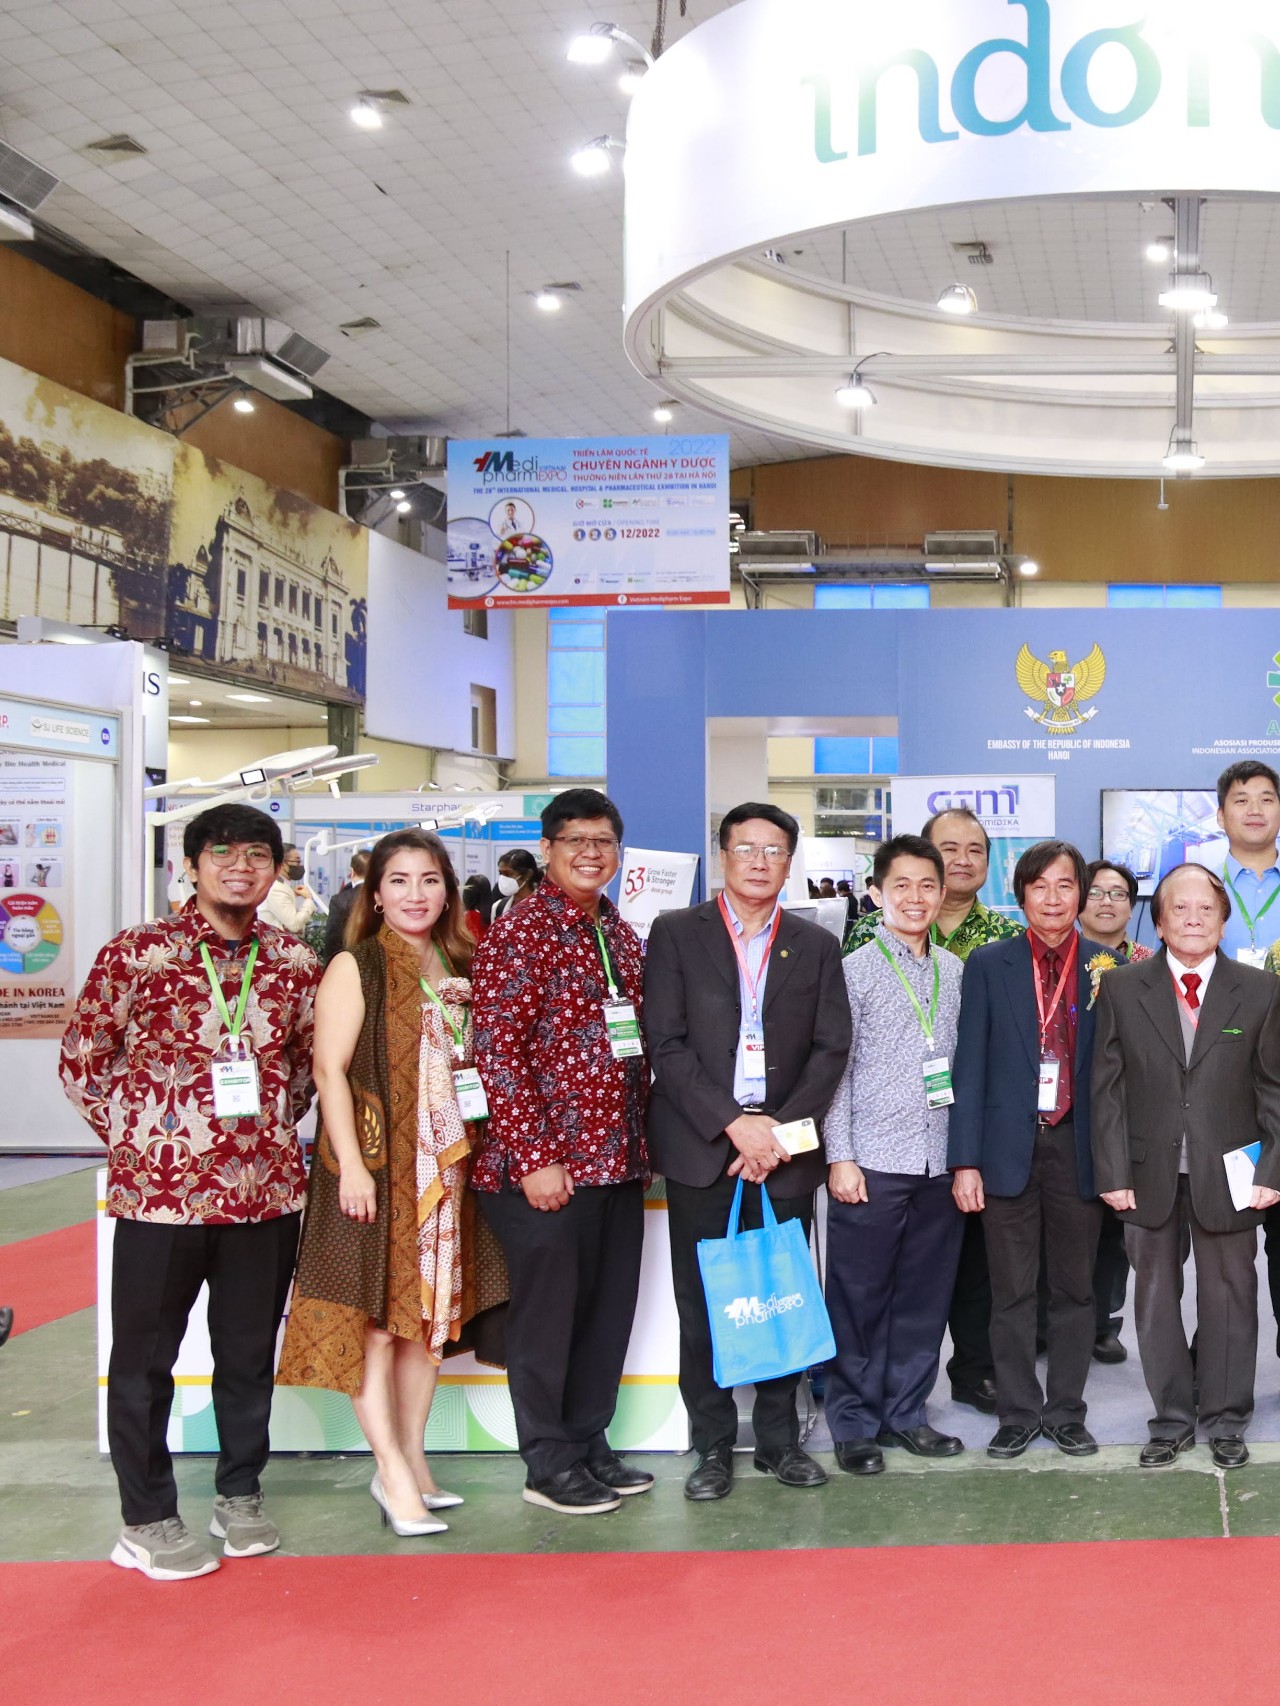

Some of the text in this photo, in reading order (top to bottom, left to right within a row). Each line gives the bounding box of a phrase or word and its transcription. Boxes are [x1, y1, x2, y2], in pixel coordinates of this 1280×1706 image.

[669, 439, 716, 455] 2022
[572, 458, 621, 471] CHUYÊN
[671, 459, 678, 468] Y
[497, 486, 540, 494] INTERNATIONAL
[621, 528, 660, 538] 12/2022
[66, 726, 89, 738] SCIENCE
[987, 739, 1131, 749] EMBASSY OF THE REPUBLIC OF INDONESIA
[1048, 750, 1070, 760] HANOI
[625, 867, 645, 895] 53
[661, 869, 677, 877] Faster
[651, 876, 676, 886] Stronger
[14, 988, 65, 997] IN KOREA
